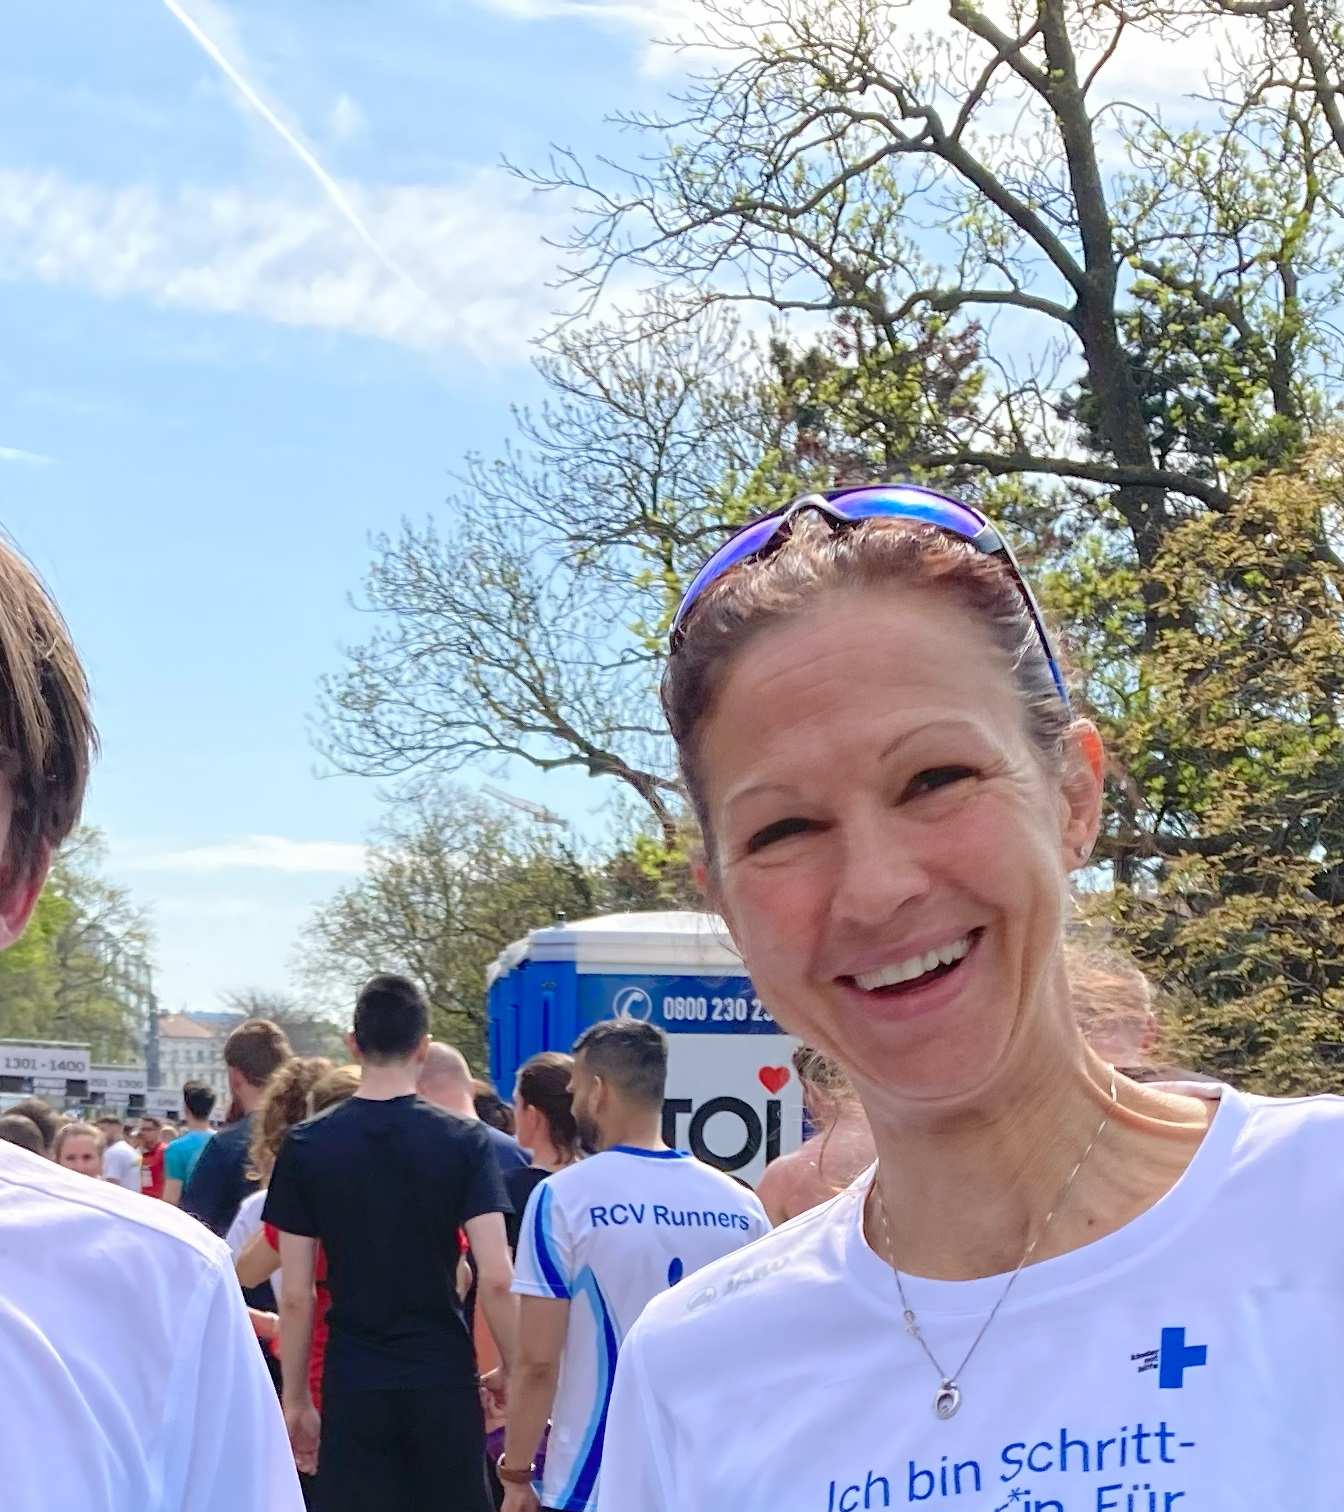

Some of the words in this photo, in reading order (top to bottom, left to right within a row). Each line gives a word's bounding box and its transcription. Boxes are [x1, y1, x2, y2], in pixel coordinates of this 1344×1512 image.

[662, 997, 707, 1022] 0800
[711, 998, 748, 1022] 230
[5, 1056, 38, 1070] 1301
[49, 1059, 86, 1074] 1400
[590, 1202, 646, 1229] RCV
[655, 1203, 751, 1232] Runners
[907, 1455, 982, 1502] bin
[999, 1421, 1196, 1482] Schritt-
